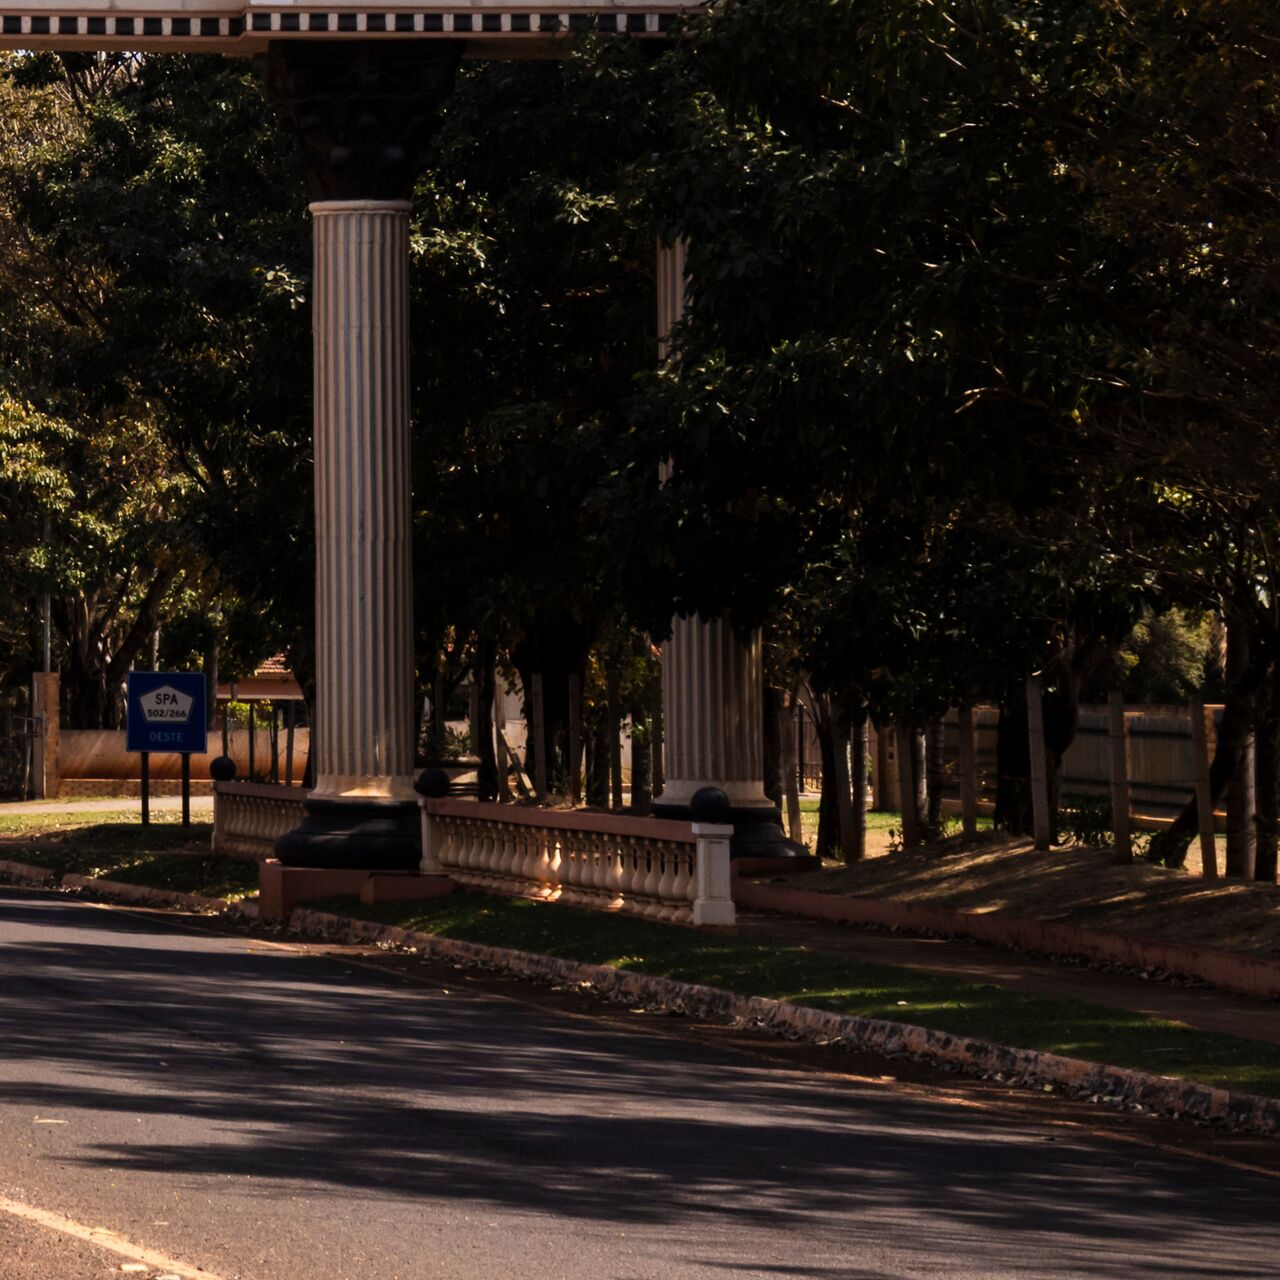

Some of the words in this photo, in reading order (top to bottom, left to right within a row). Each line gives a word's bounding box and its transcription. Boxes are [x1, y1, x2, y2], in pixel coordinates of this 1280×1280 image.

[155, 693, 178, 706] SPA
[147, 709, 187, 718] 502/266
[149, 731, 184, 742] OESTE
